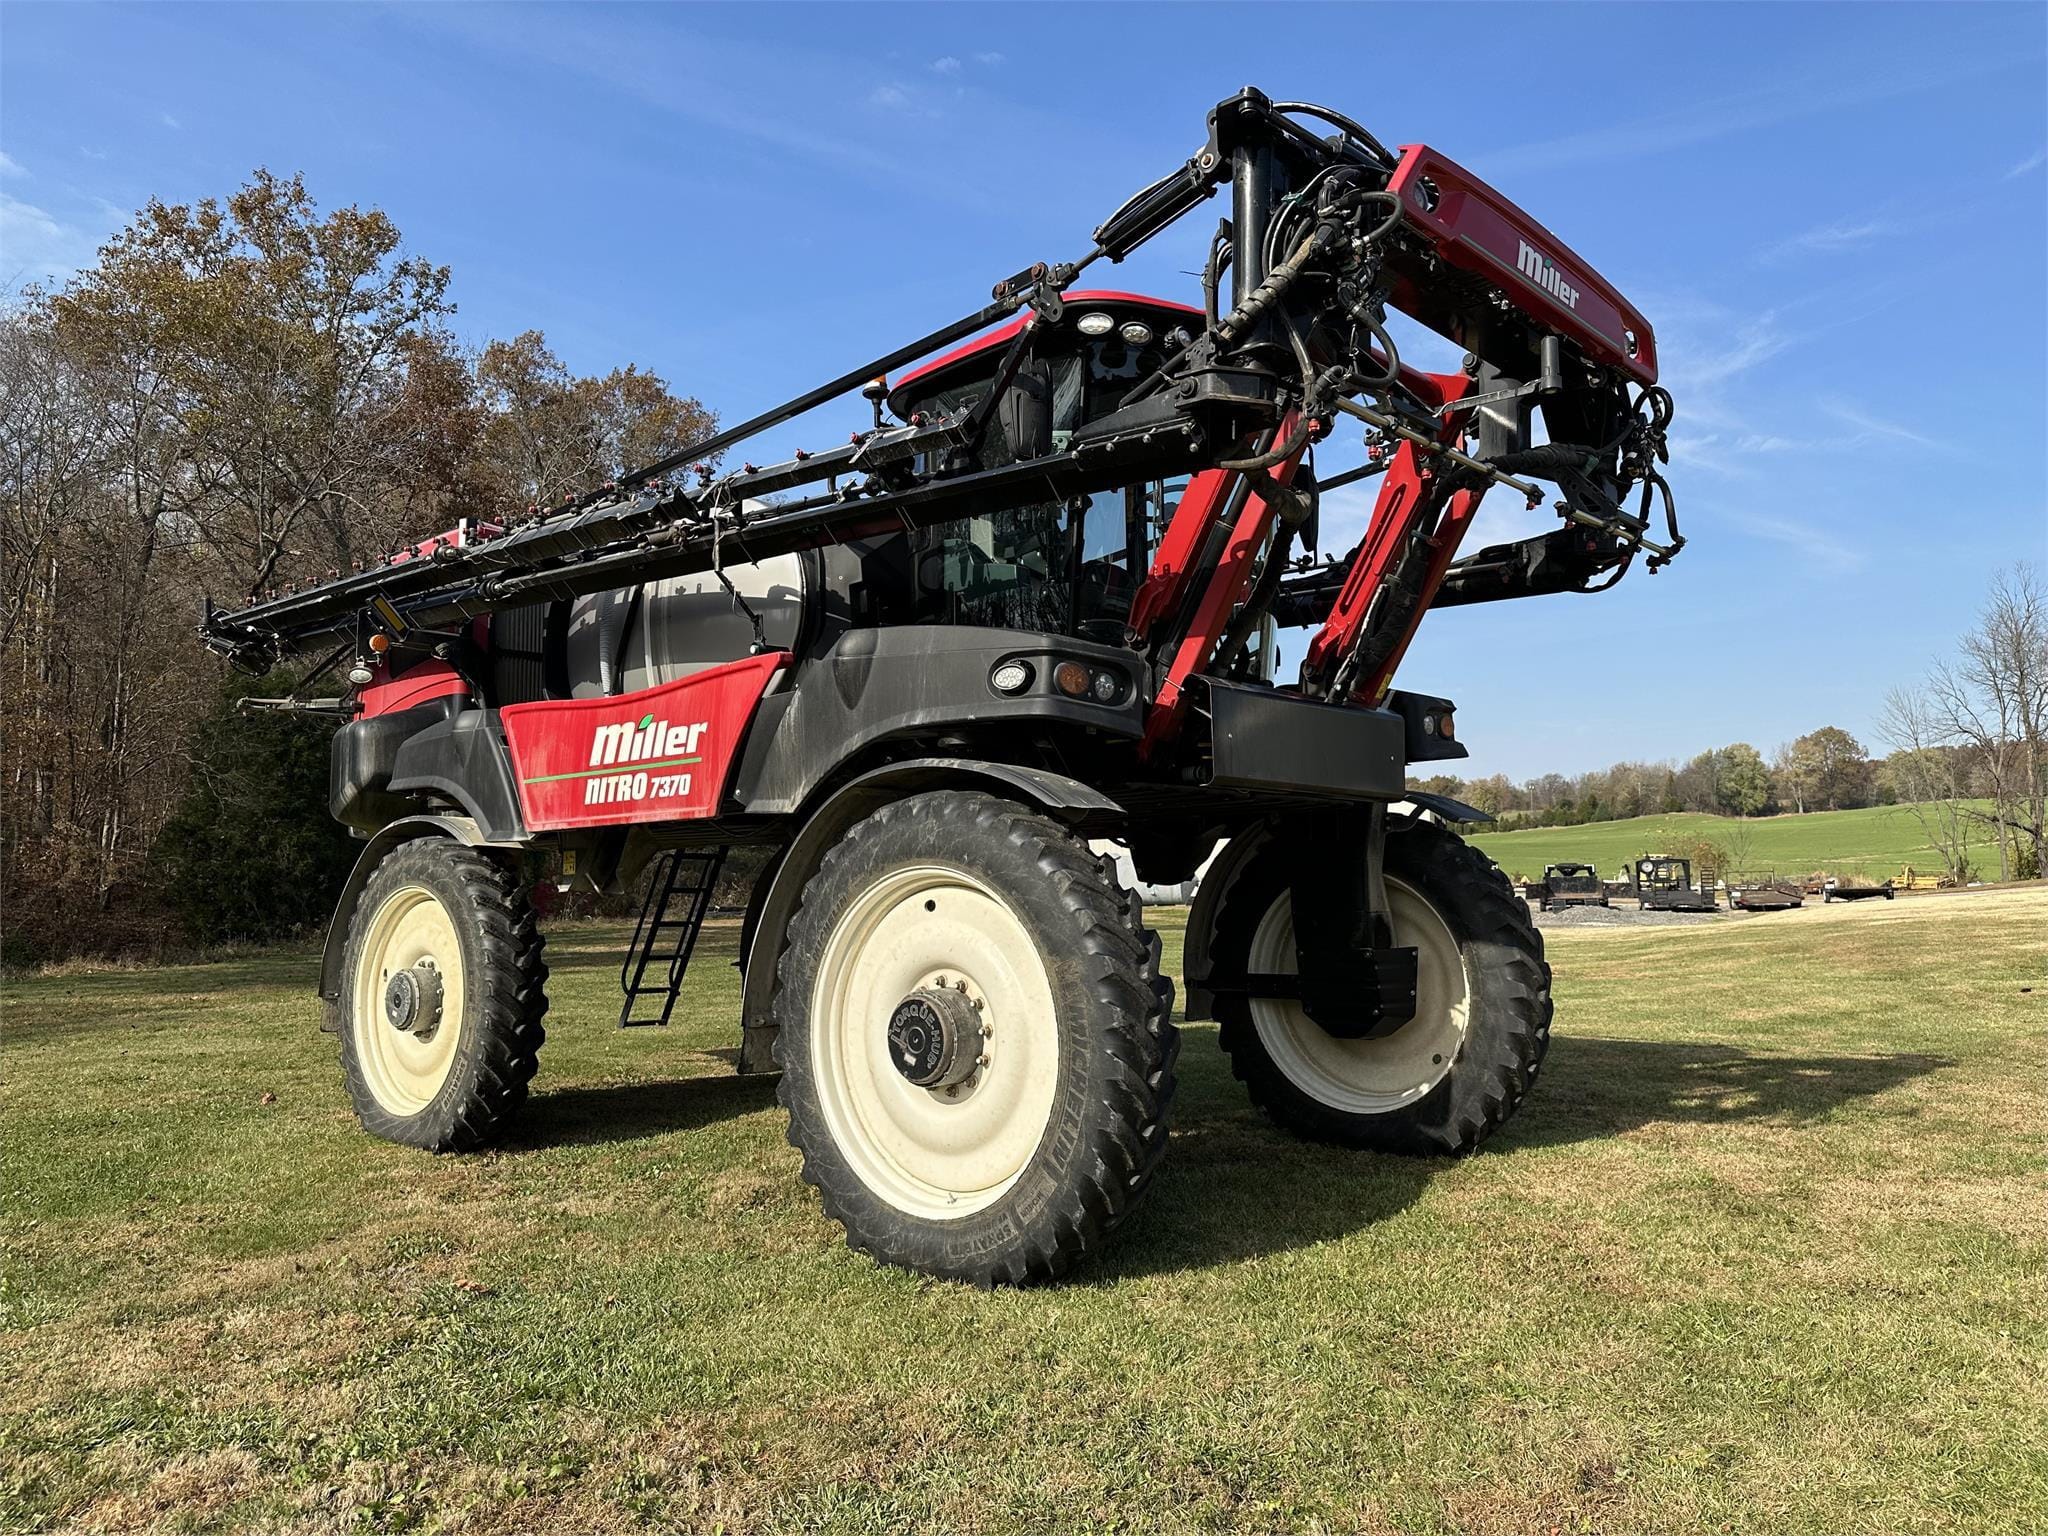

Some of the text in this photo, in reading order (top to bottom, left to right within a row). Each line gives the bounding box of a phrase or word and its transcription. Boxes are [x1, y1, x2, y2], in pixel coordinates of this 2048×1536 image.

[1516, 239, 1580, 309] Miller
[589, 713, 709, 767] Miller
[584, 772, 691, 805] NITRO 7370
